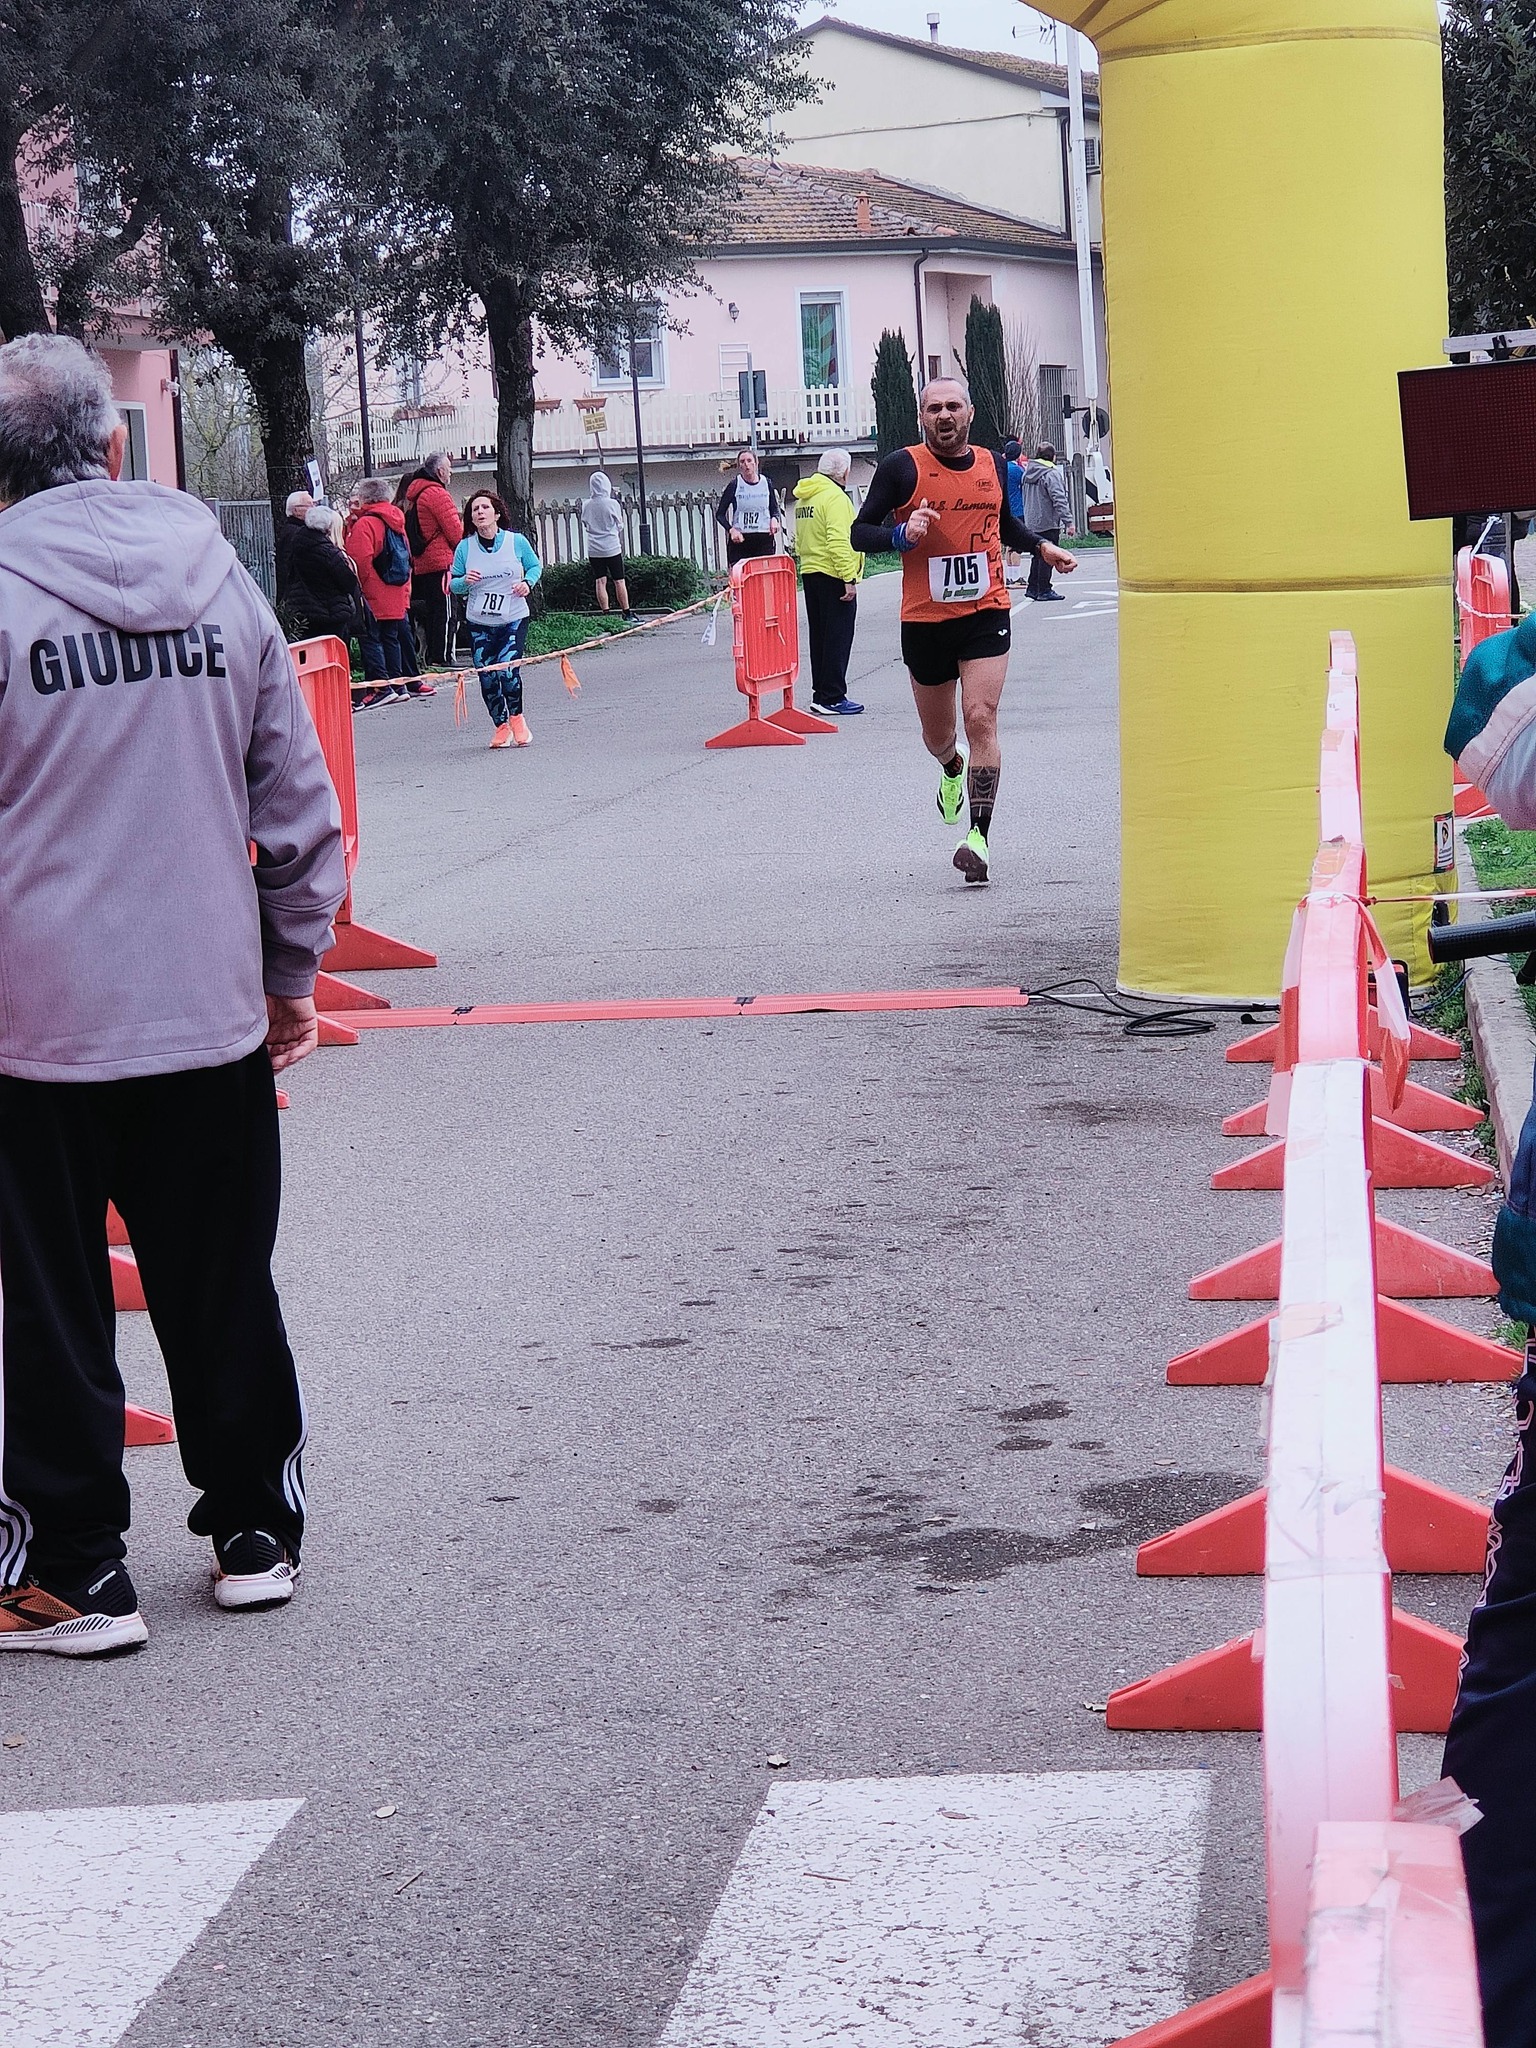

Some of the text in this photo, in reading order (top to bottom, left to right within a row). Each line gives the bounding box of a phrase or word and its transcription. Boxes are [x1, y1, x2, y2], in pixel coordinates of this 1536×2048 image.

[941, 555, 979, 587] 705
[482, 592, 505, 611] 787
[29, 623, 226, 695] GIUDICE
